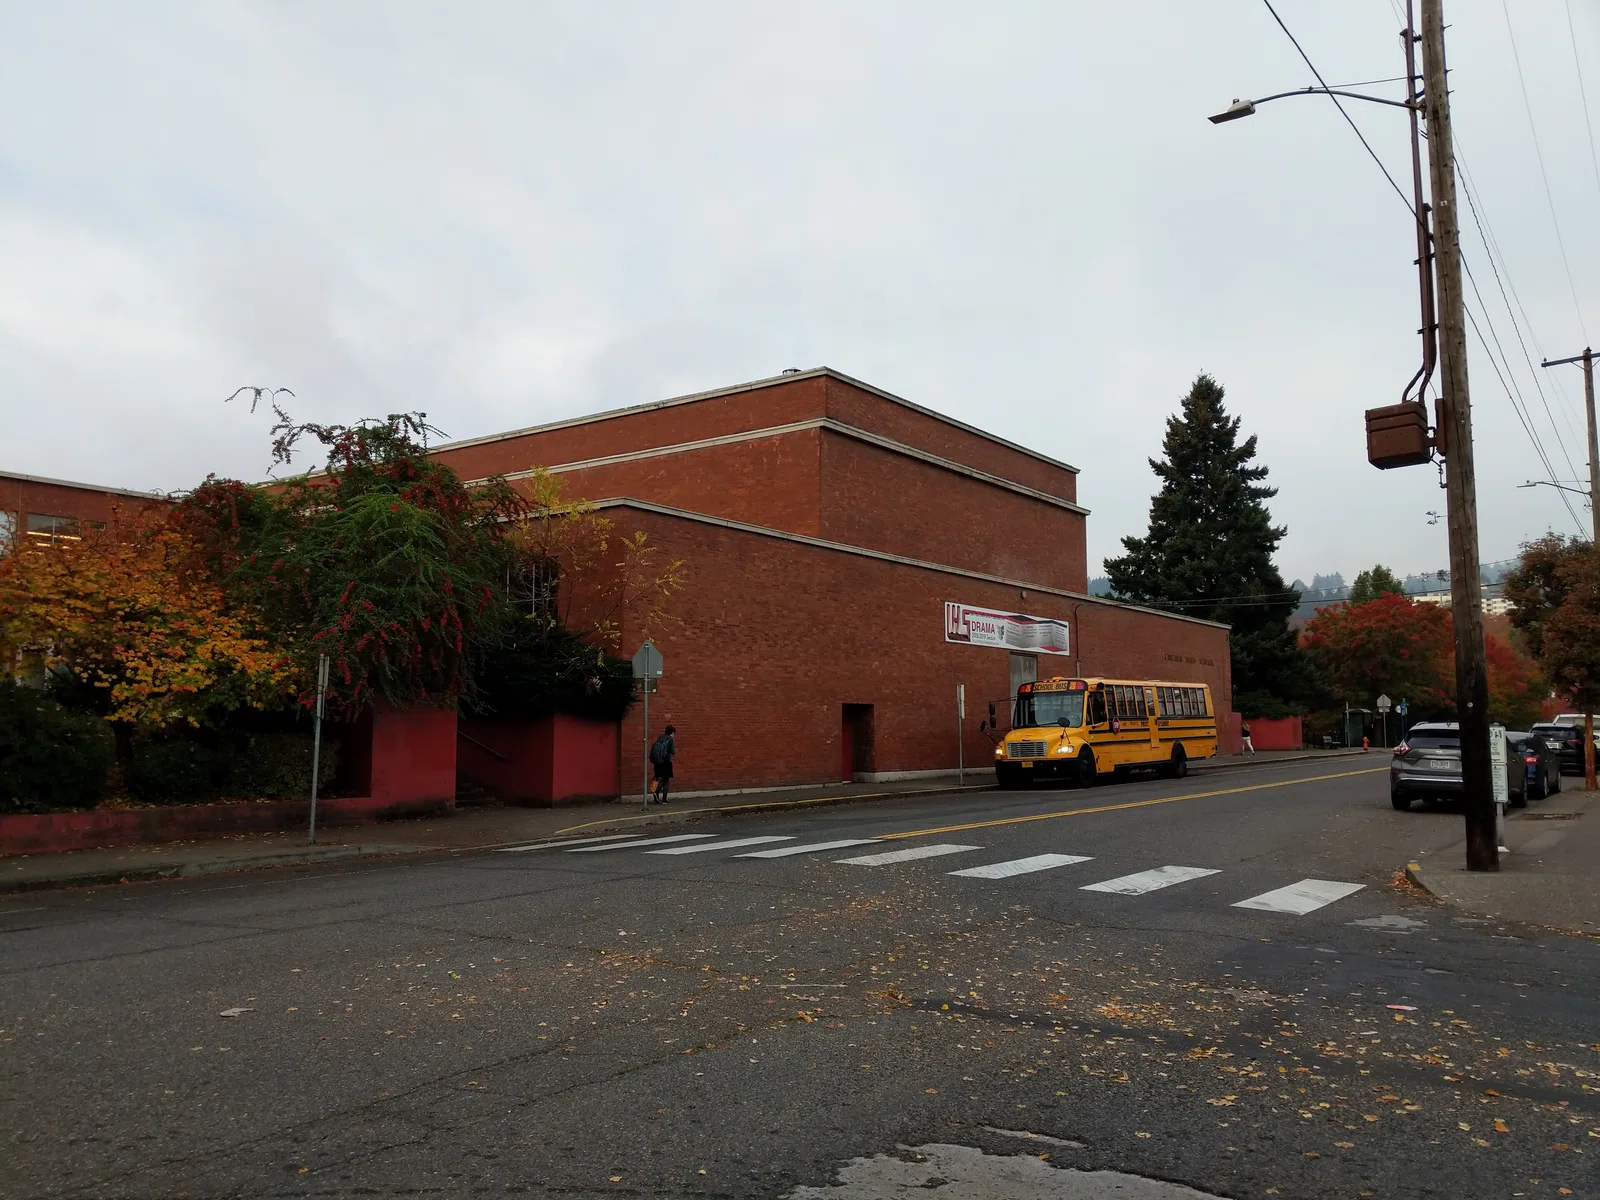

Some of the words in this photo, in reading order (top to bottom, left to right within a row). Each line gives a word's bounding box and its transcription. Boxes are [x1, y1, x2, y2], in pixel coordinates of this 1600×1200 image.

[971, 620, 996, 634] DRAMA
[1033, 683, 1054, 691] SCHOOL
[1055, 682, 1067, 690] BUS
